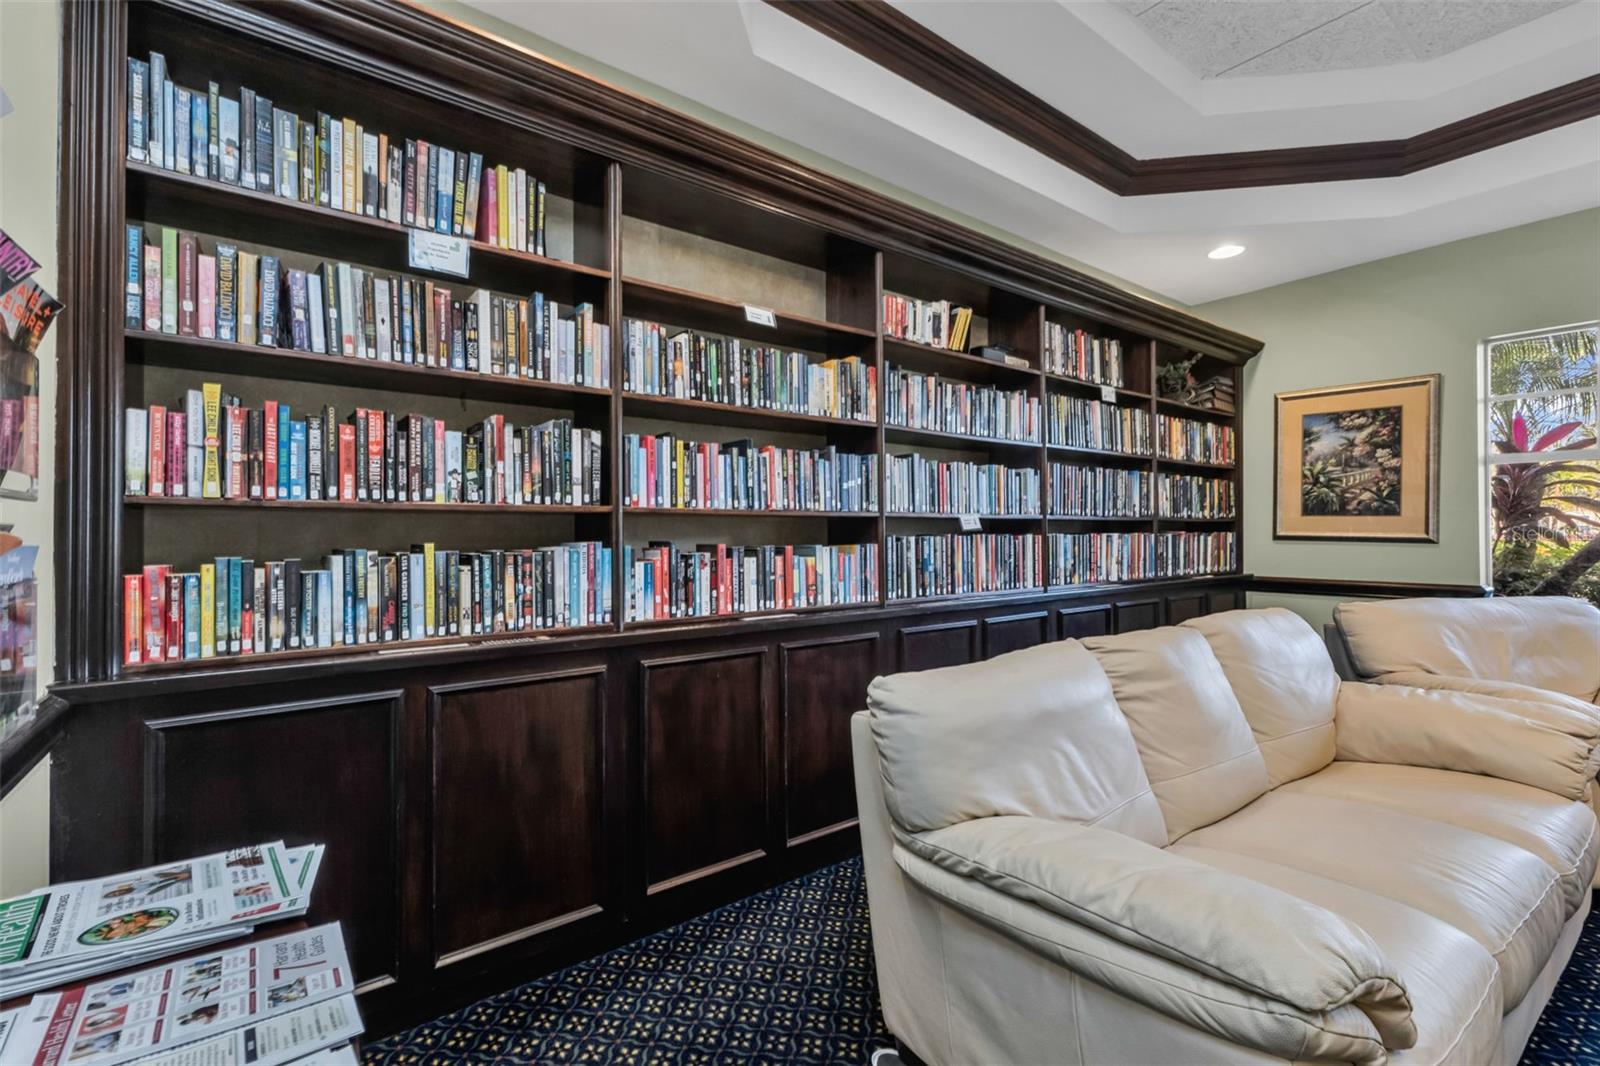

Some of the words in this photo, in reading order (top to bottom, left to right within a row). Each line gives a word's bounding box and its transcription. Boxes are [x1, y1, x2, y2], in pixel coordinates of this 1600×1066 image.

[273, 942, 288, 966] Harvard
[293, 941, 305, 962] Health
[311, 935, 326, 956] Guides
